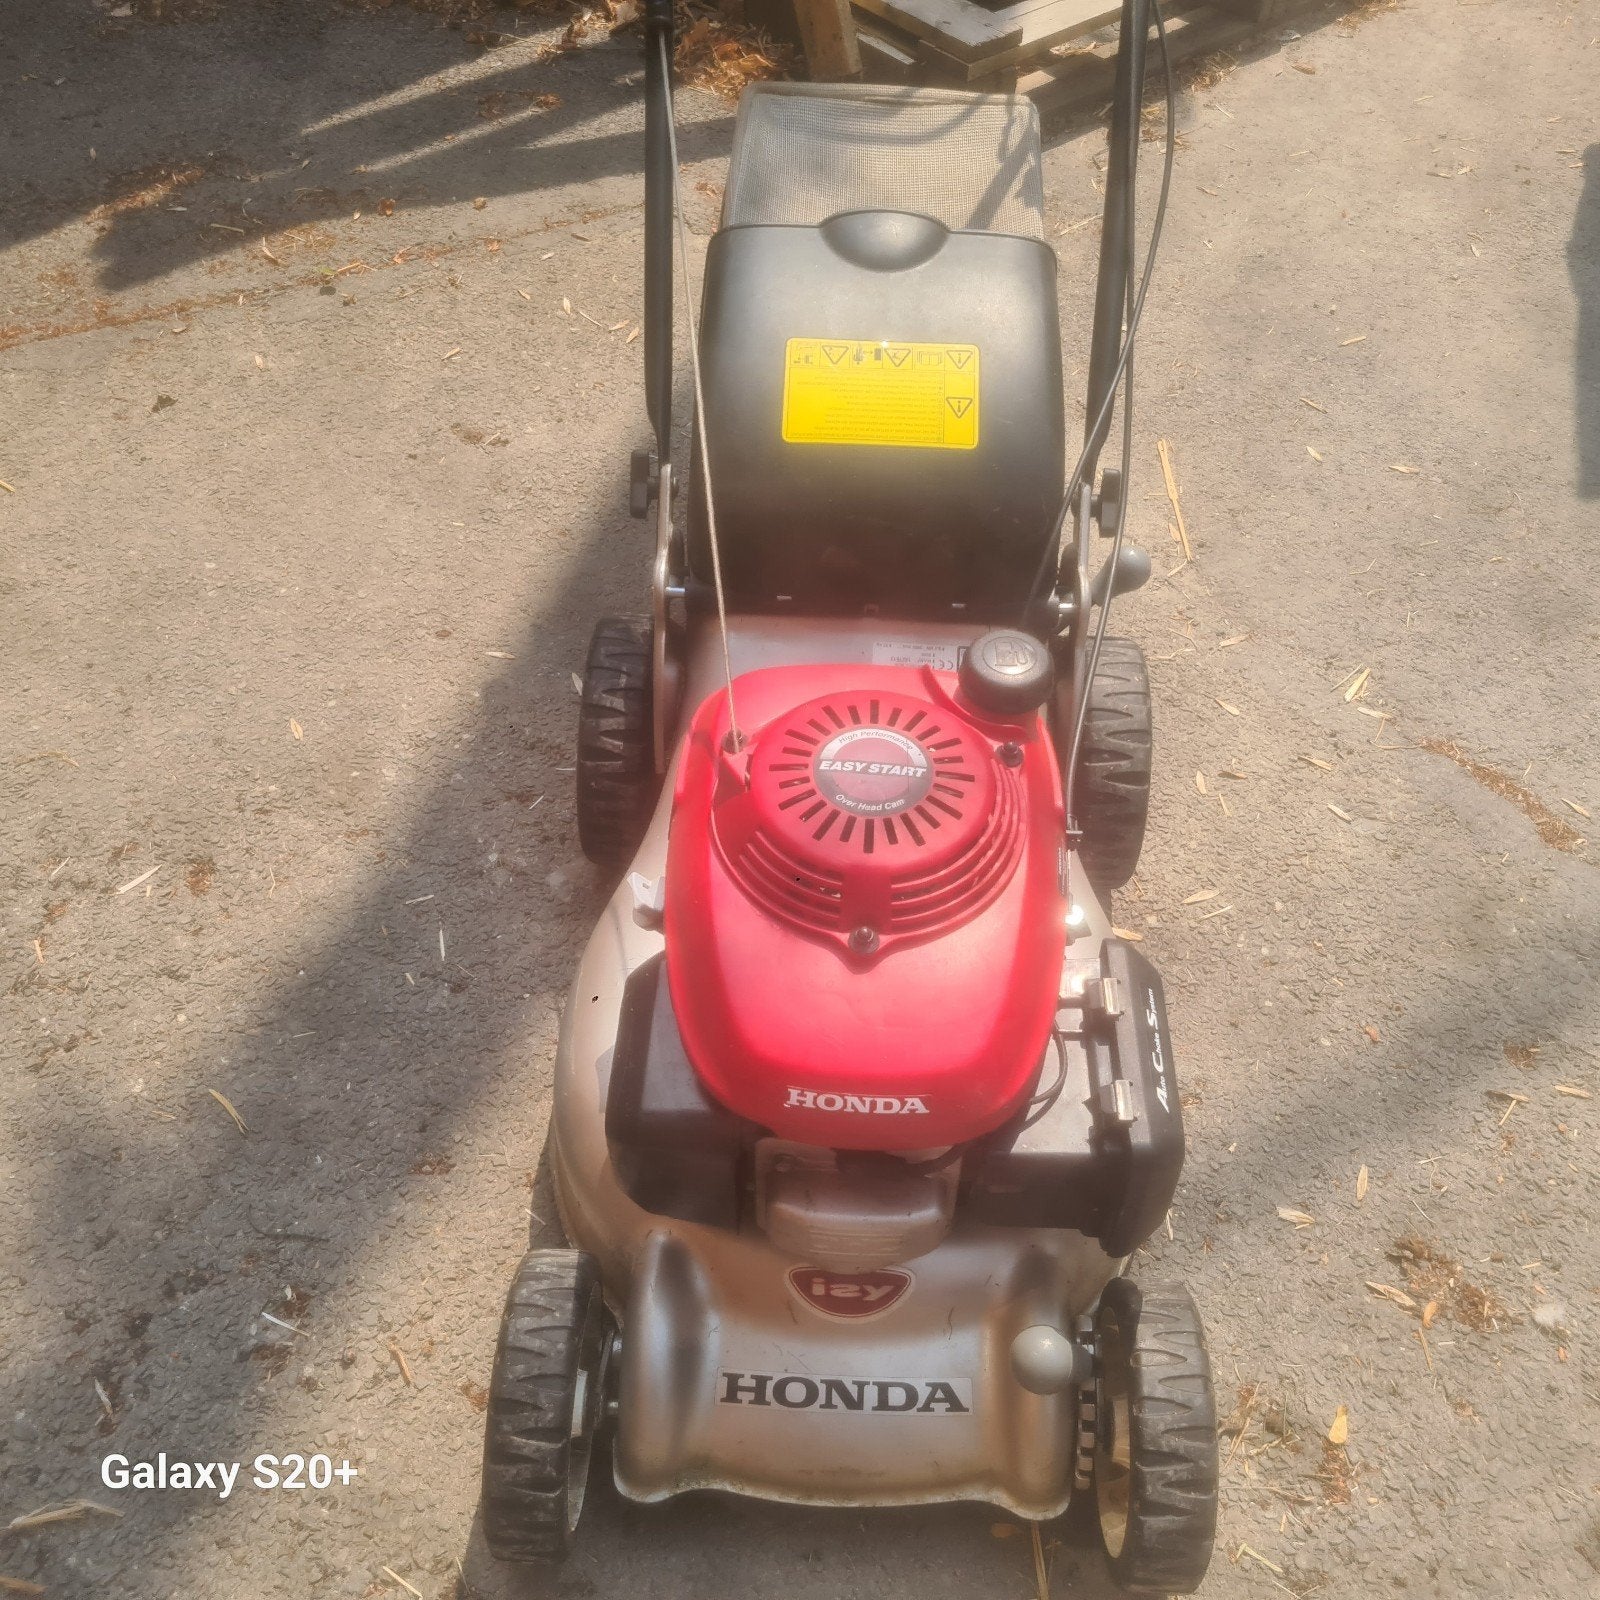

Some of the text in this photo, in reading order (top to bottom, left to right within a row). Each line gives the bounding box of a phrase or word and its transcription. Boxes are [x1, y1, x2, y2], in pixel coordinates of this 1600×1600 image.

[839, 730, 914, 750] High Performance
[819, 760, 926, 778] EASY START
[835, 794, 905, 812] Over Head Cam
[1146, 988, 1170, 1114] Auto Choke System
[786, 1087, 930, 1115] HONDA
[811, 1278, 897, 1302] izy
[720, 1371, 970, 1414] HONDA
